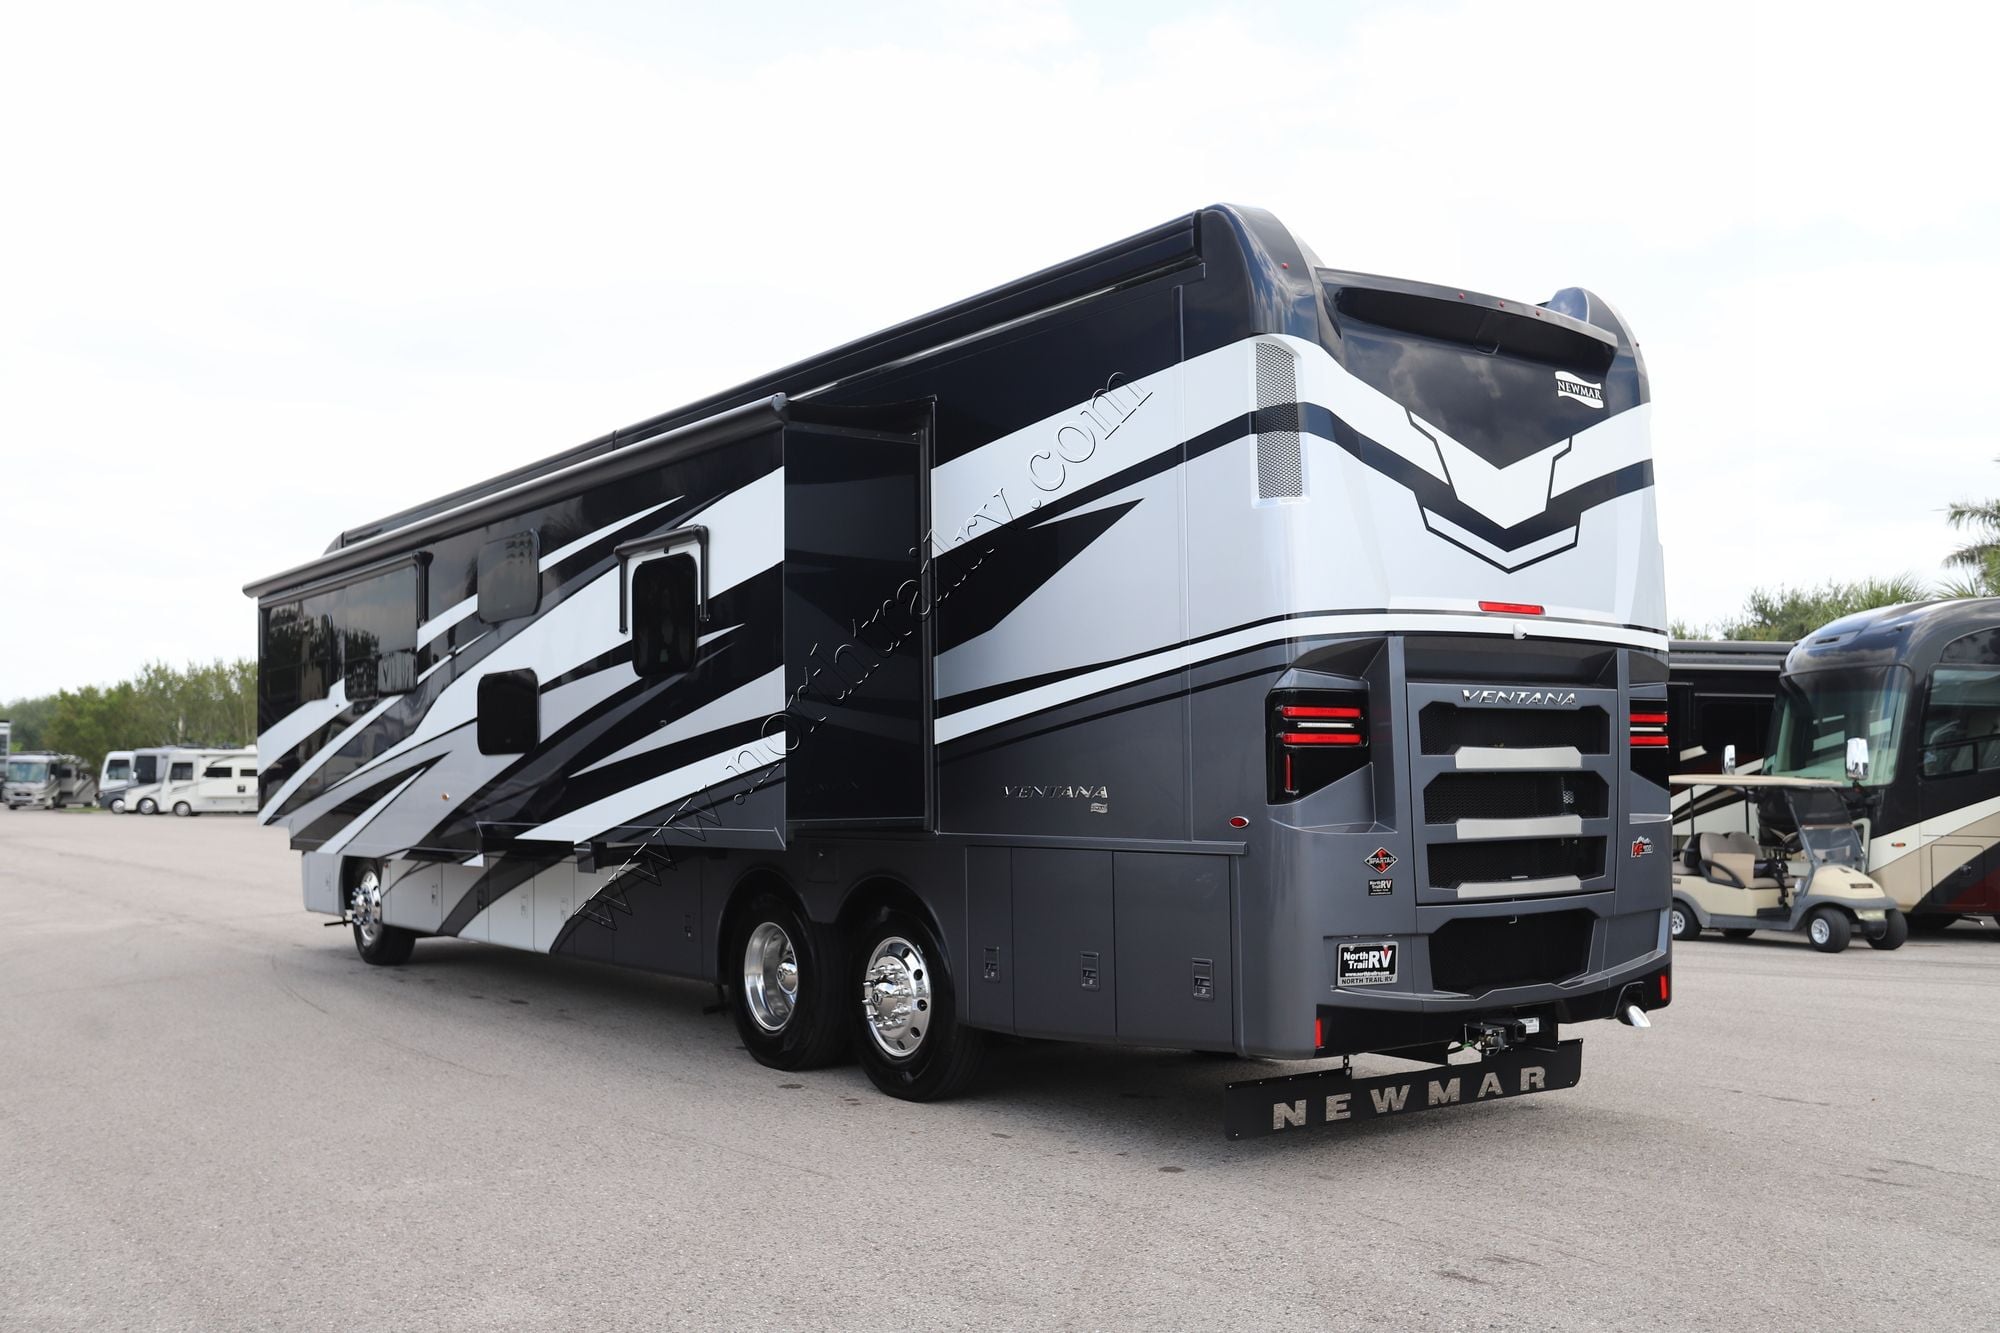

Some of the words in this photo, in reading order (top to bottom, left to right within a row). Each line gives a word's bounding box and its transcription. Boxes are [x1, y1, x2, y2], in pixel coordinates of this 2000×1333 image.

[1557, 380, 1602, 400] NEWMAR
[1462, 689, 1576, 706] VENTANA
[1002, 785, 1108, 799] VENTANA
[1380, 880, 1392, 889] RV
[1343, 951, 1368, 961] North
[1368, 950, 1393, 969] RV
[1347, 960, 1368, 970] Trail
[1273, 1065, 1546, 1130] NEWMAR
